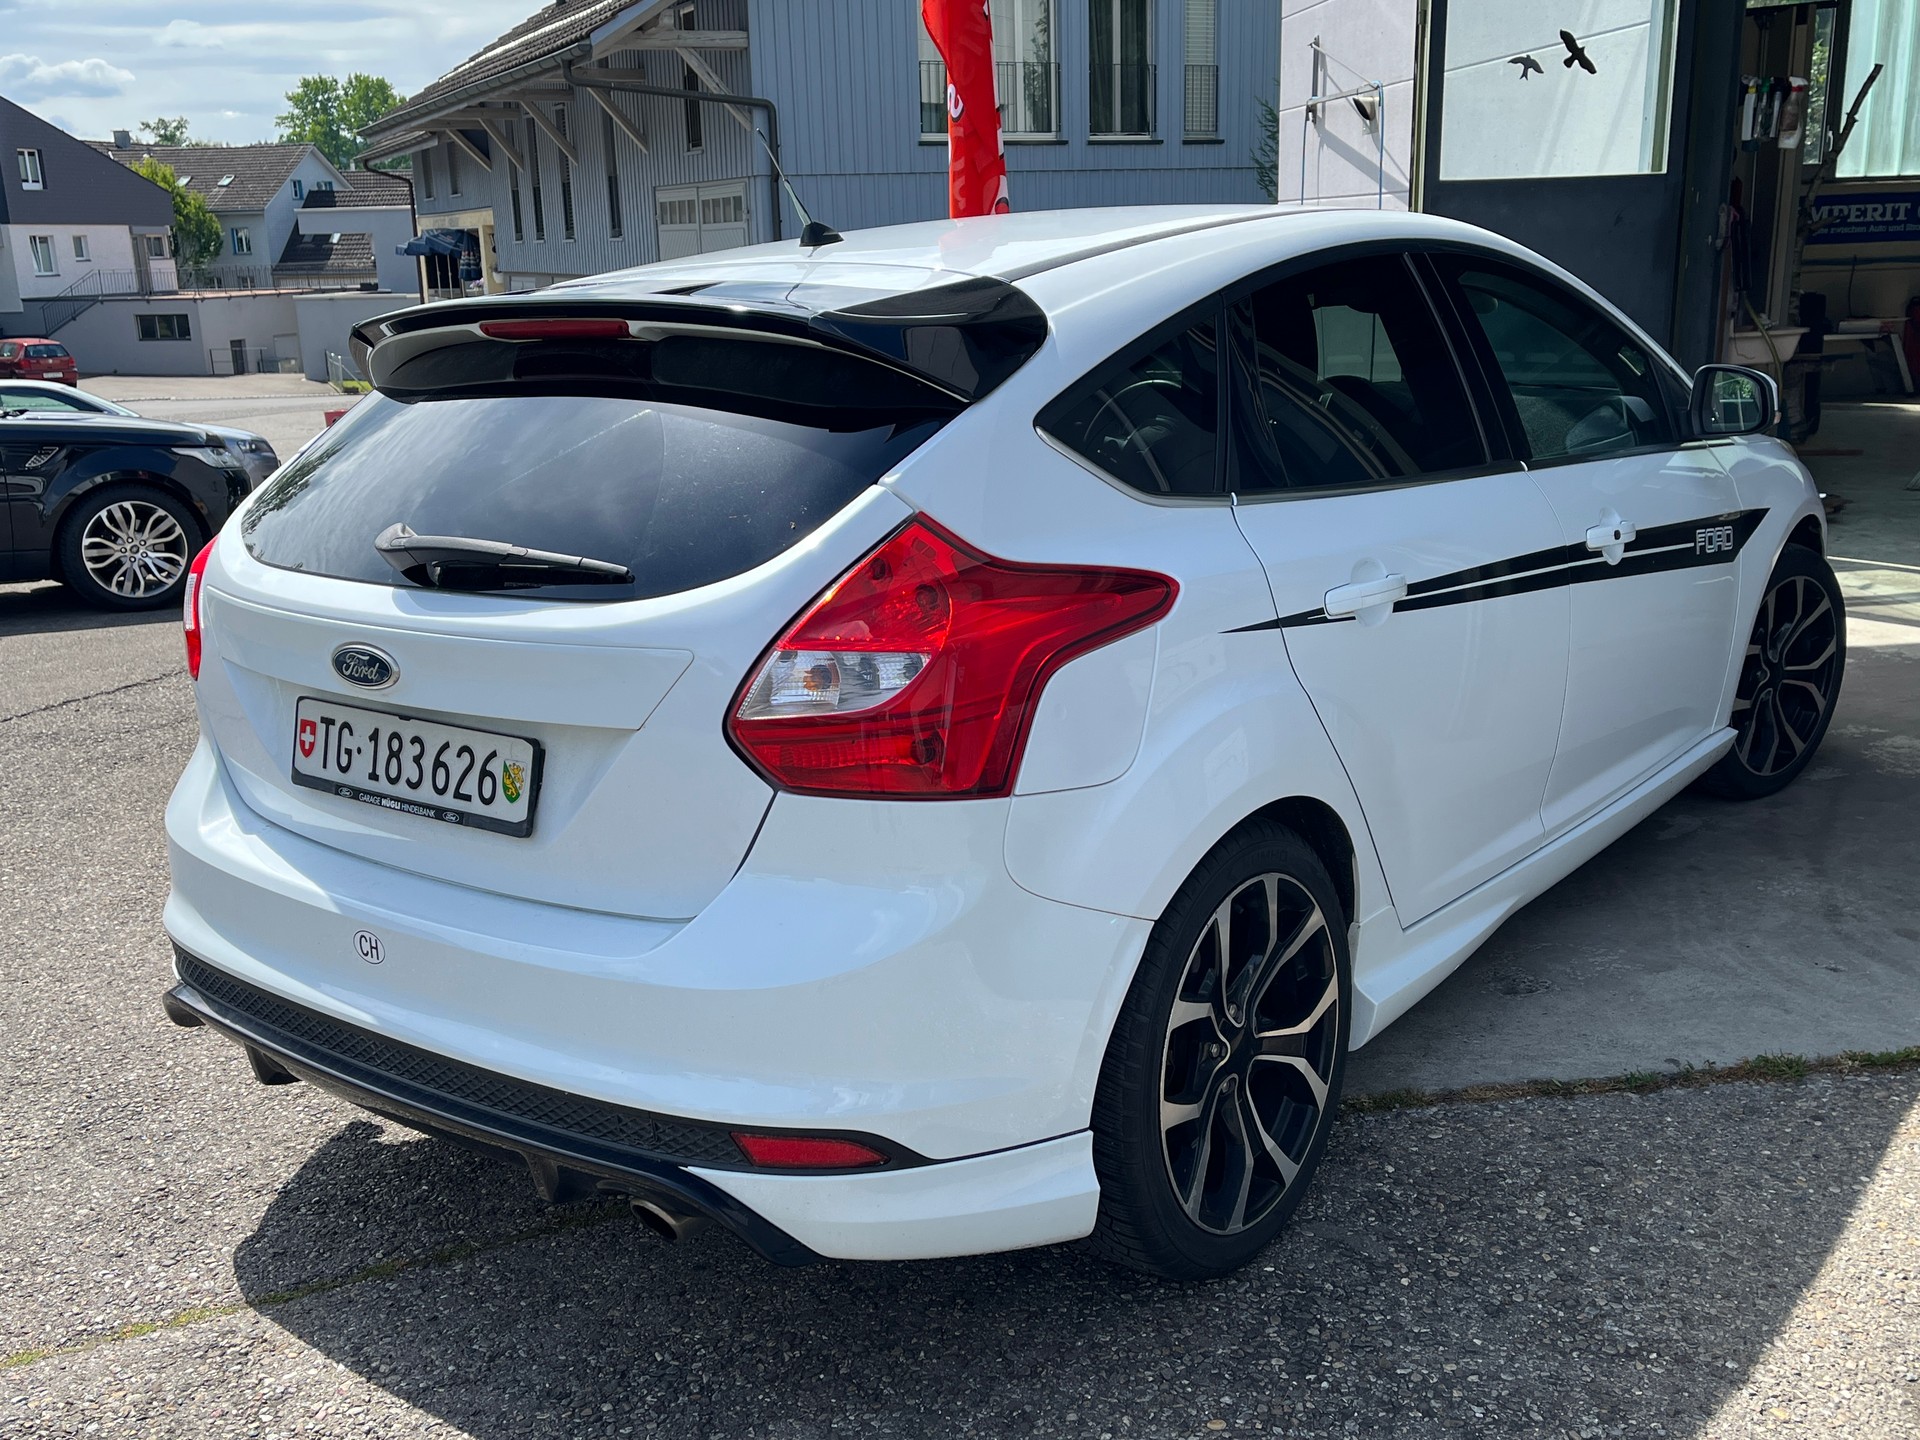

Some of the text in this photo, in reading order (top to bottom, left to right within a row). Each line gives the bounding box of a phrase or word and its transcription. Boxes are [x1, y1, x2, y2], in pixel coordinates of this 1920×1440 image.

[1806, 202, 1912, 224] MPERIT
[341, 652, 380, 682] Ford
[358, 792, 436, 818] GARAGE HÜGLI HINDELBANK
[359, 934, 380, 961] CH
